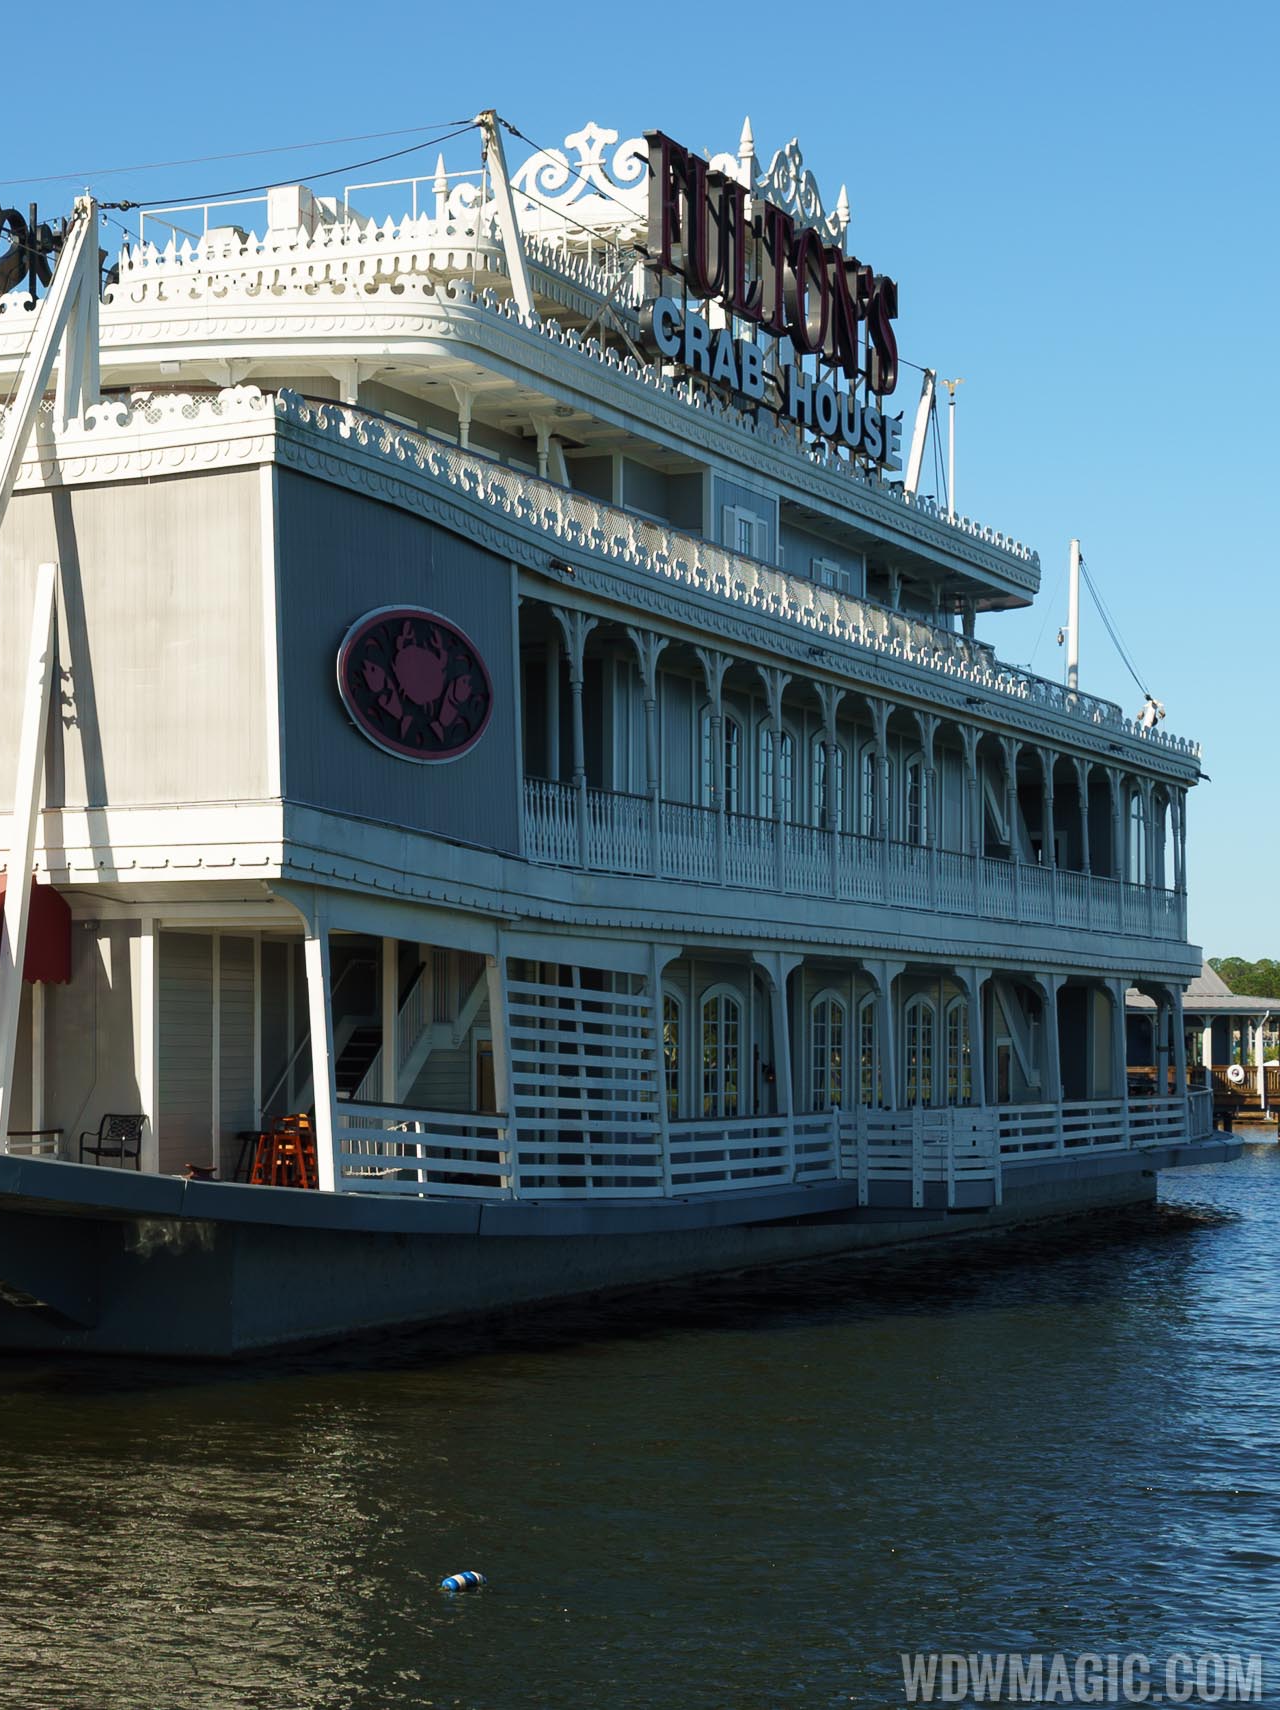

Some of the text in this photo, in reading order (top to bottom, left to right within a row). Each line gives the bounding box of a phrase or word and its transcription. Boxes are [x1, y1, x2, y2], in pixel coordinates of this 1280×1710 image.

[643, 129, 899, 396] FULTON'S
[640, 296, 903, 472] CRAB HOUSE
